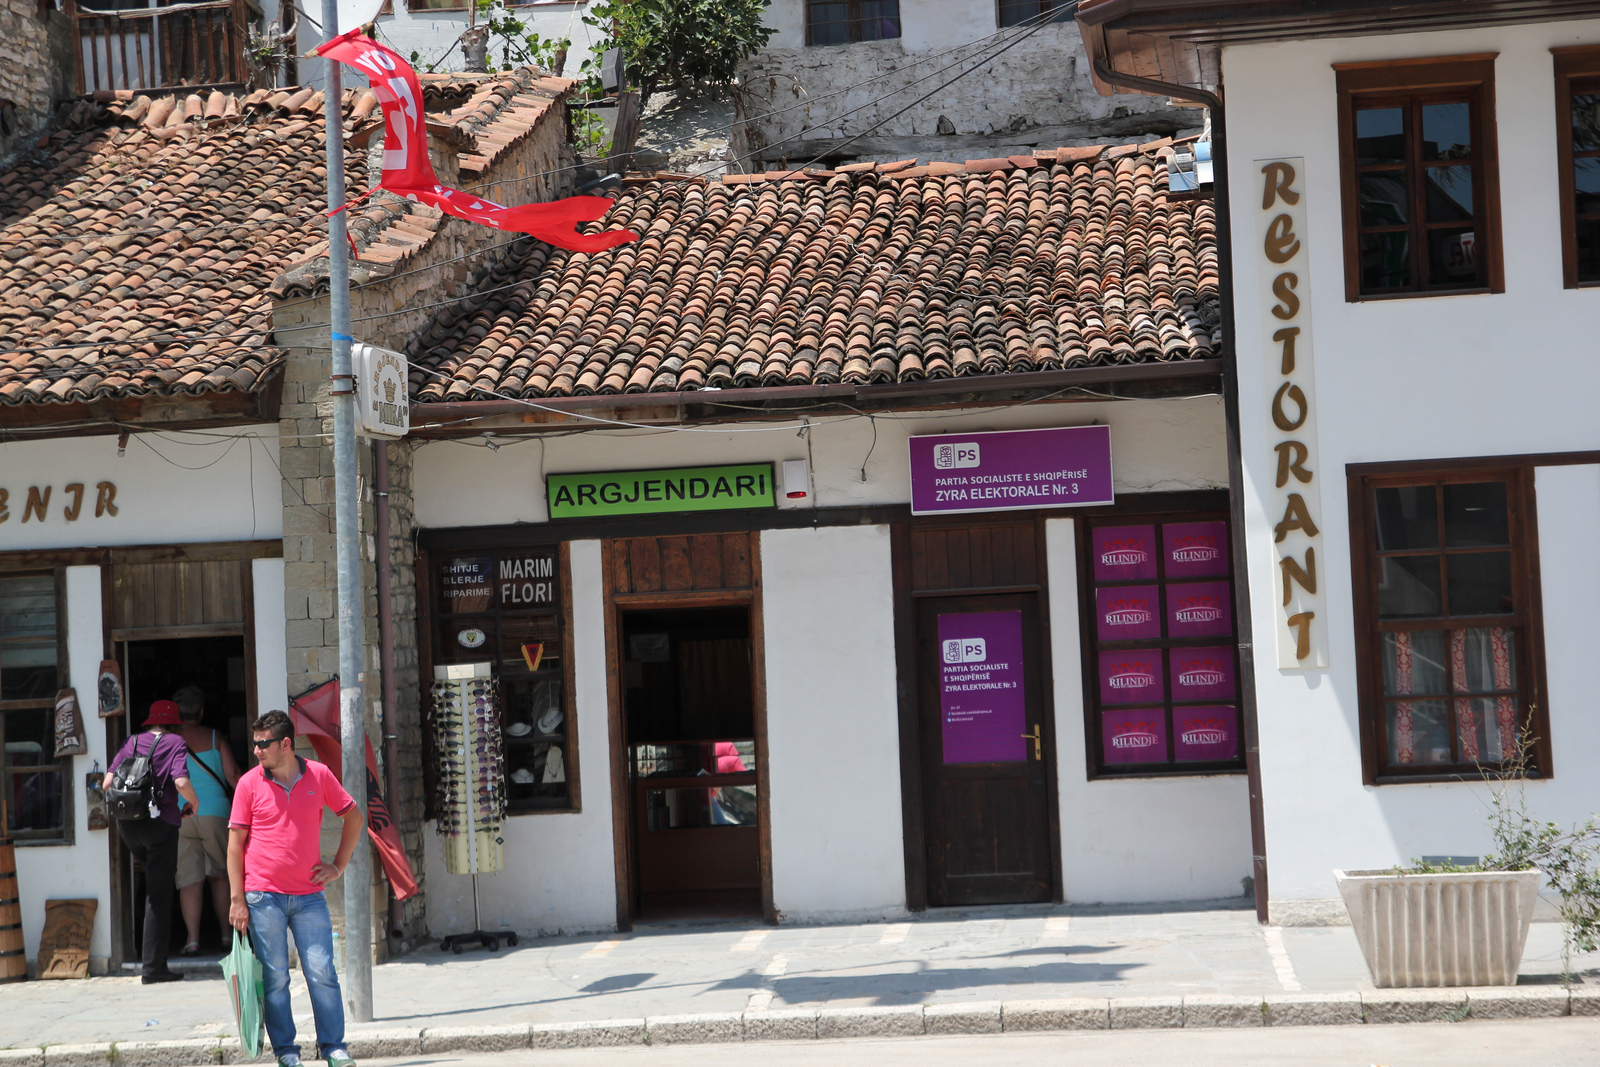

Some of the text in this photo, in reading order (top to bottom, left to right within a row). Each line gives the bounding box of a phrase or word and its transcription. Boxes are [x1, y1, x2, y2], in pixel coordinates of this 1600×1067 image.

[1261, 161, 1320, 662] RESTORANT
[958, 449, 977, 461] PS
[935, 468, 1088, 487] PARTIA SOCIALISTE E SHQIPËRISË
[553, 474, 766, 507] ARGJENDARI
[935, 482, 1079, 502] ZYRA ELEKTORALE Nr. 3
[1101, 553, 1148, 564] RILINDJE
[1172, 550, 1219, 561] RILINDJE
[442, 564, 479, 574] SHITJE
[500, 558, 553, 579] MARIM
[443, 575, 484, 585] BLERJE
[443, 588, 490, 598] RIPARIME
[502, 582, 552, 603] FLORI
[1105, 613, 1152, 624] RILINDJE
[1175, 610, 1223, 621] RILINDJE
[965, 645, 982, 656] PS
[943, 663, 1009, 673] PARTIA SOCIALISTE
[950, 672, 990, 682] SHQIPËRISË
[1109, 676, 1155, 687] RILINDJE
[1178, 674, 1226, 684] RILINDJE
[962, 682, 1002, 691] ELEKTORALE
[1112, 736, 1158, 747] RILINDJE
[1181, 733, 1228, 744] RILINDJE
